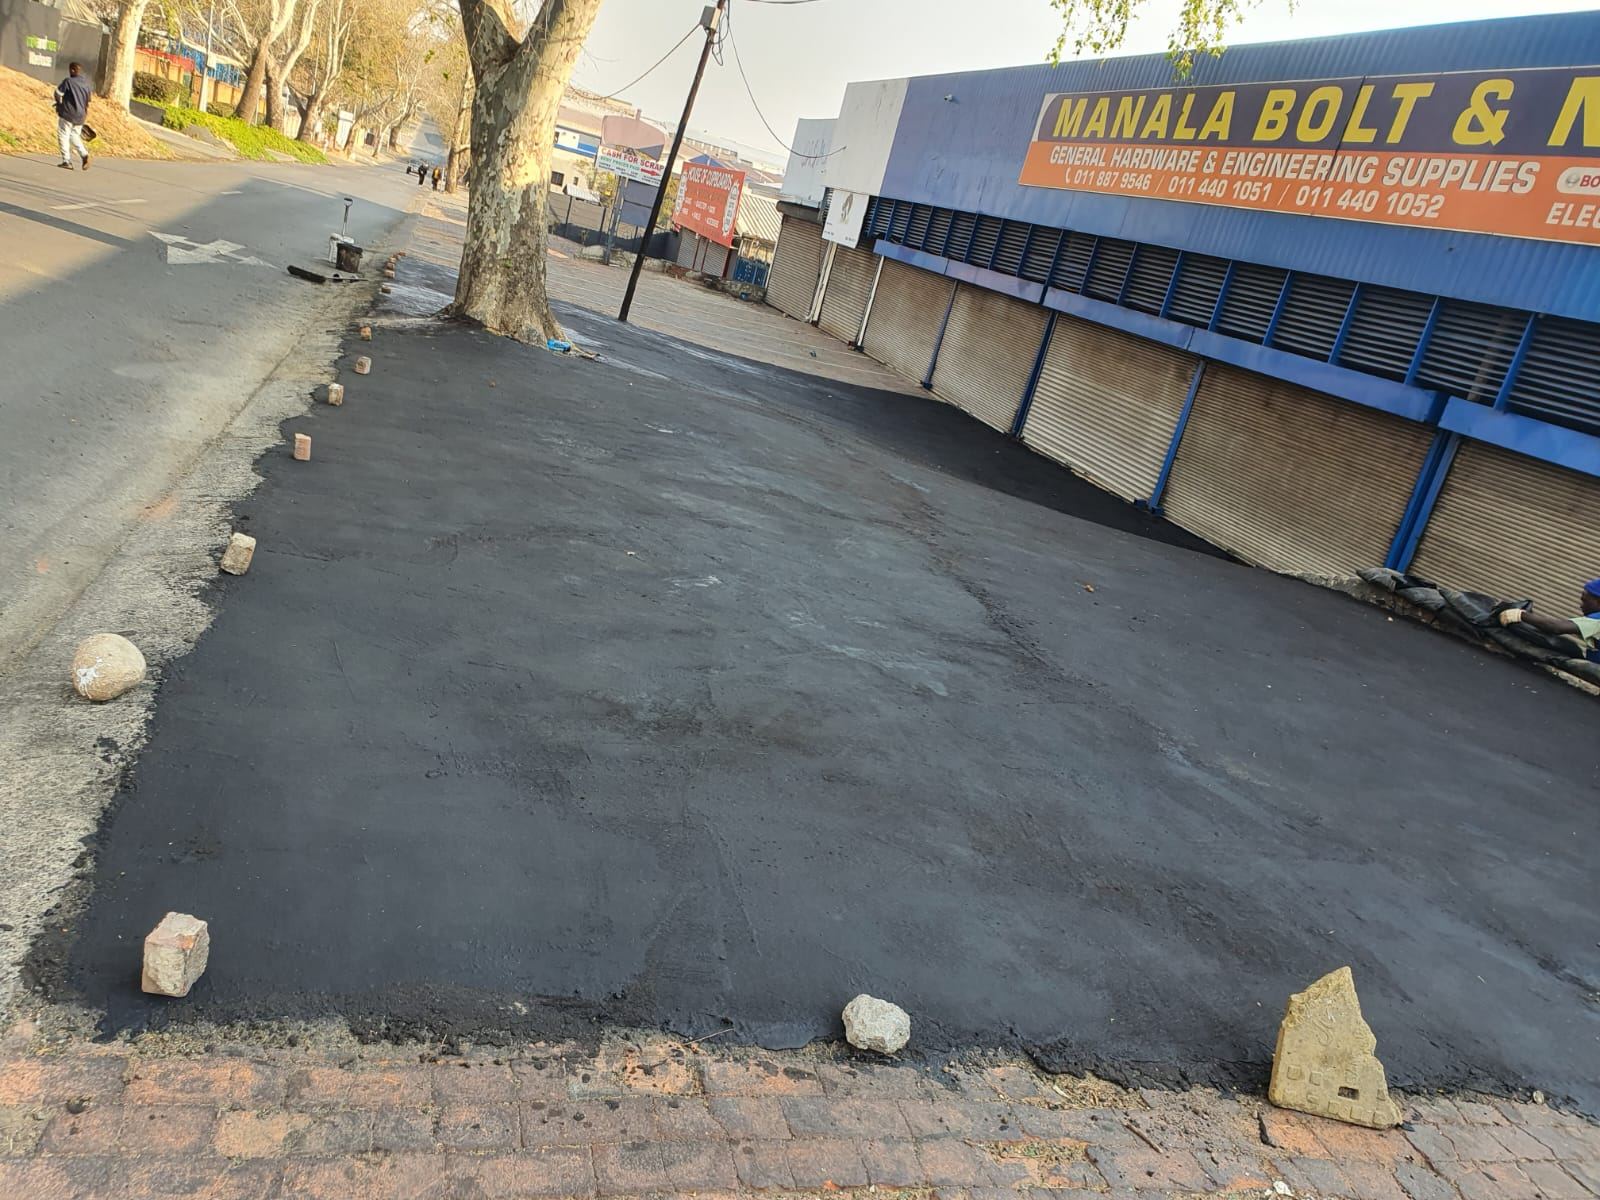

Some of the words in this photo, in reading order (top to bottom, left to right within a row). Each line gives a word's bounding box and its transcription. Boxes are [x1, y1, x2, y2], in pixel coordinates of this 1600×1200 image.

[1052, 91, 1236, 141] MANALA
[1252, 81, 1436, 144] BOLT
[1452, 78, 1515, 146] &
[601, 147, 623, 158] CASH
[623, 154, 639, 165] FOR
[640, 159, 665, 171] SCRAP
[1050, 145, 1107, 167] GENERAL
[1110, 147, 1202, 173] HARDWARE
[1203, 150, 1218, 175] &
[1221, 151, 1379, 184] ENGINEERING
[1382, 156, 1541, 194] SUPPLIES
[1074, 169, 1096, 185] 011
[1096, 171, 1120, 187] 887
[1120, 172, 1152, 190] 9546
[1168, 175, 1196, 195] 011
[1198, 177, 1228, 198] 440
[1232, 180, 1273, 203] 1051
[1295, 185, 1333, 208] 011
[1336, 188, 1380, 213] 440
[1386, 192, 1446, 218] 1052
